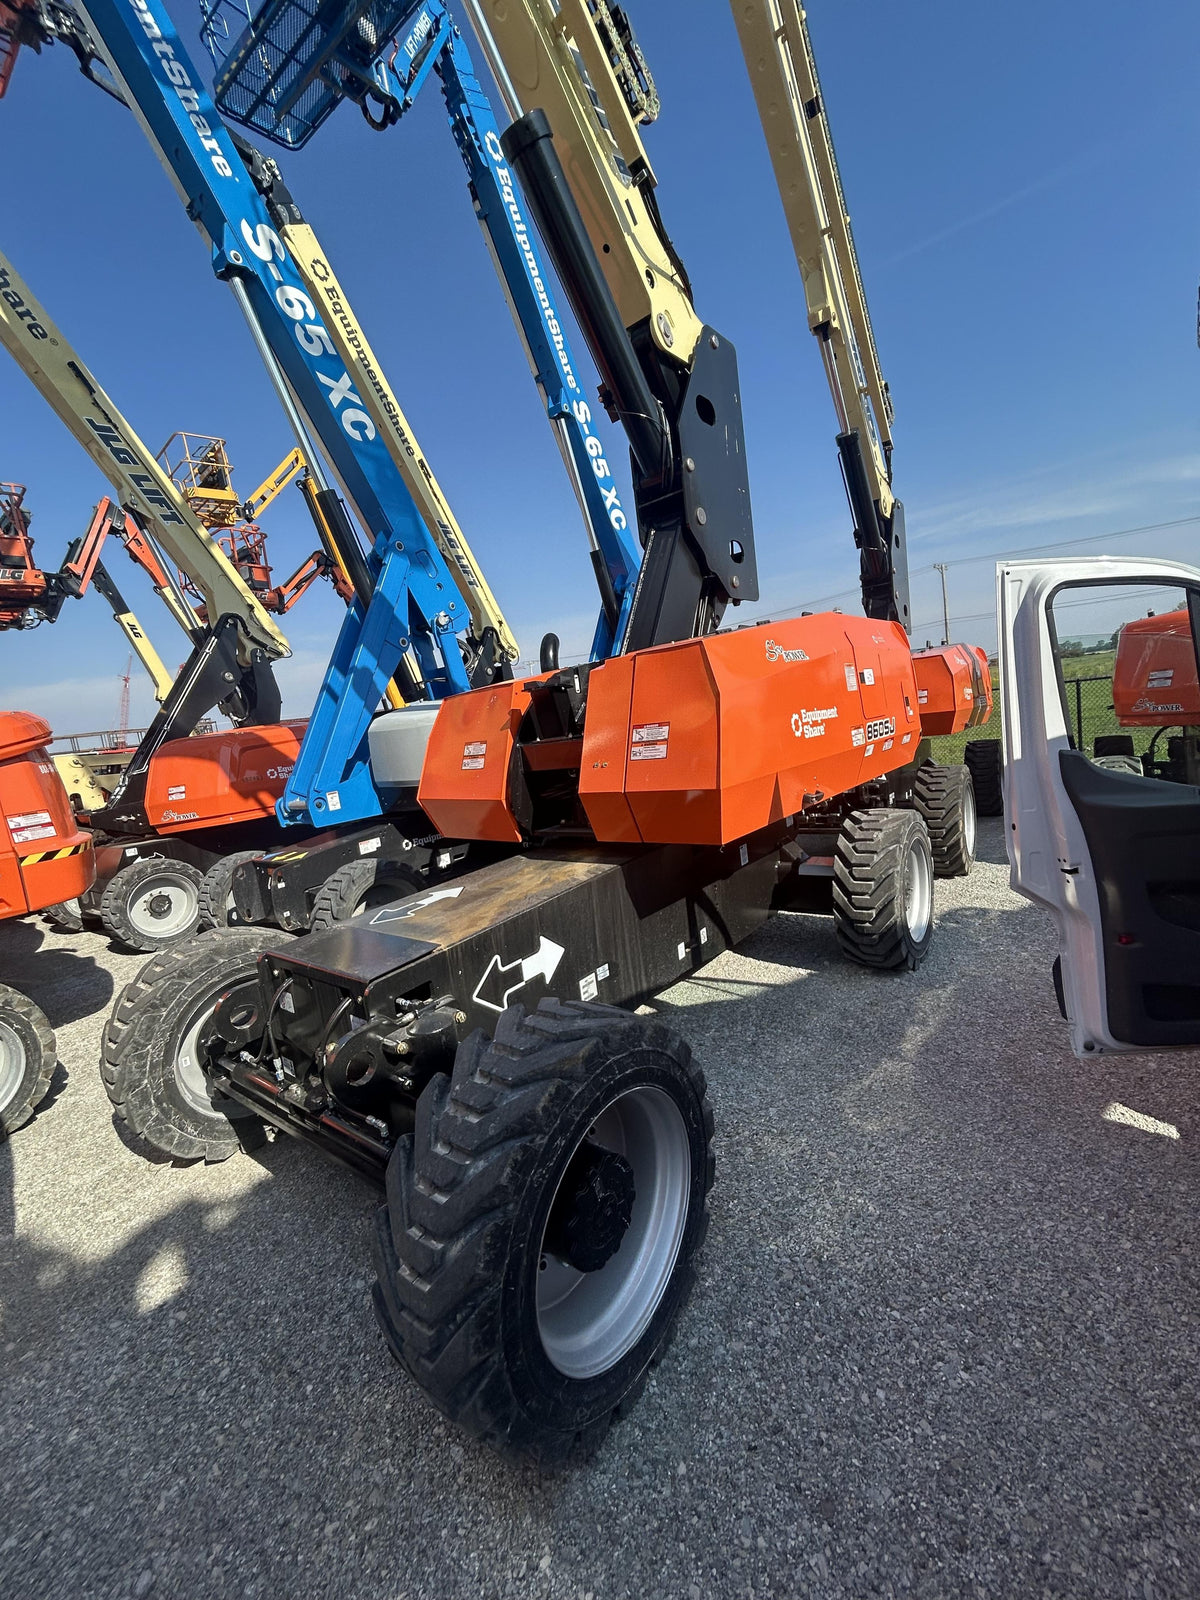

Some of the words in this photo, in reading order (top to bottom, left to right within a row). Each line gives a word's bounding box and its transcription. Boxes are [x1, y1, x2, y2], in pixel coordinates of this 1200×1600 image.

[241, 218, 337, 357] S-65
[316, 371, 376, 442] XC
[500, 167, 578, 389] EquipmentShare
[324, 286, 415, 457] EquipmentShare
[84, 416, 140, 466] JLG
[128, 473, 186, 526] LIFT
[573, 400, 611, 479] S-65
[600, 486, 627, 531] XC
[436, 519, 460, 552] JLG
[454, 553, 480, 588] LIFT
[127, 622, 143, 638] JLG
[800, 706, 838, 724] Equipment
